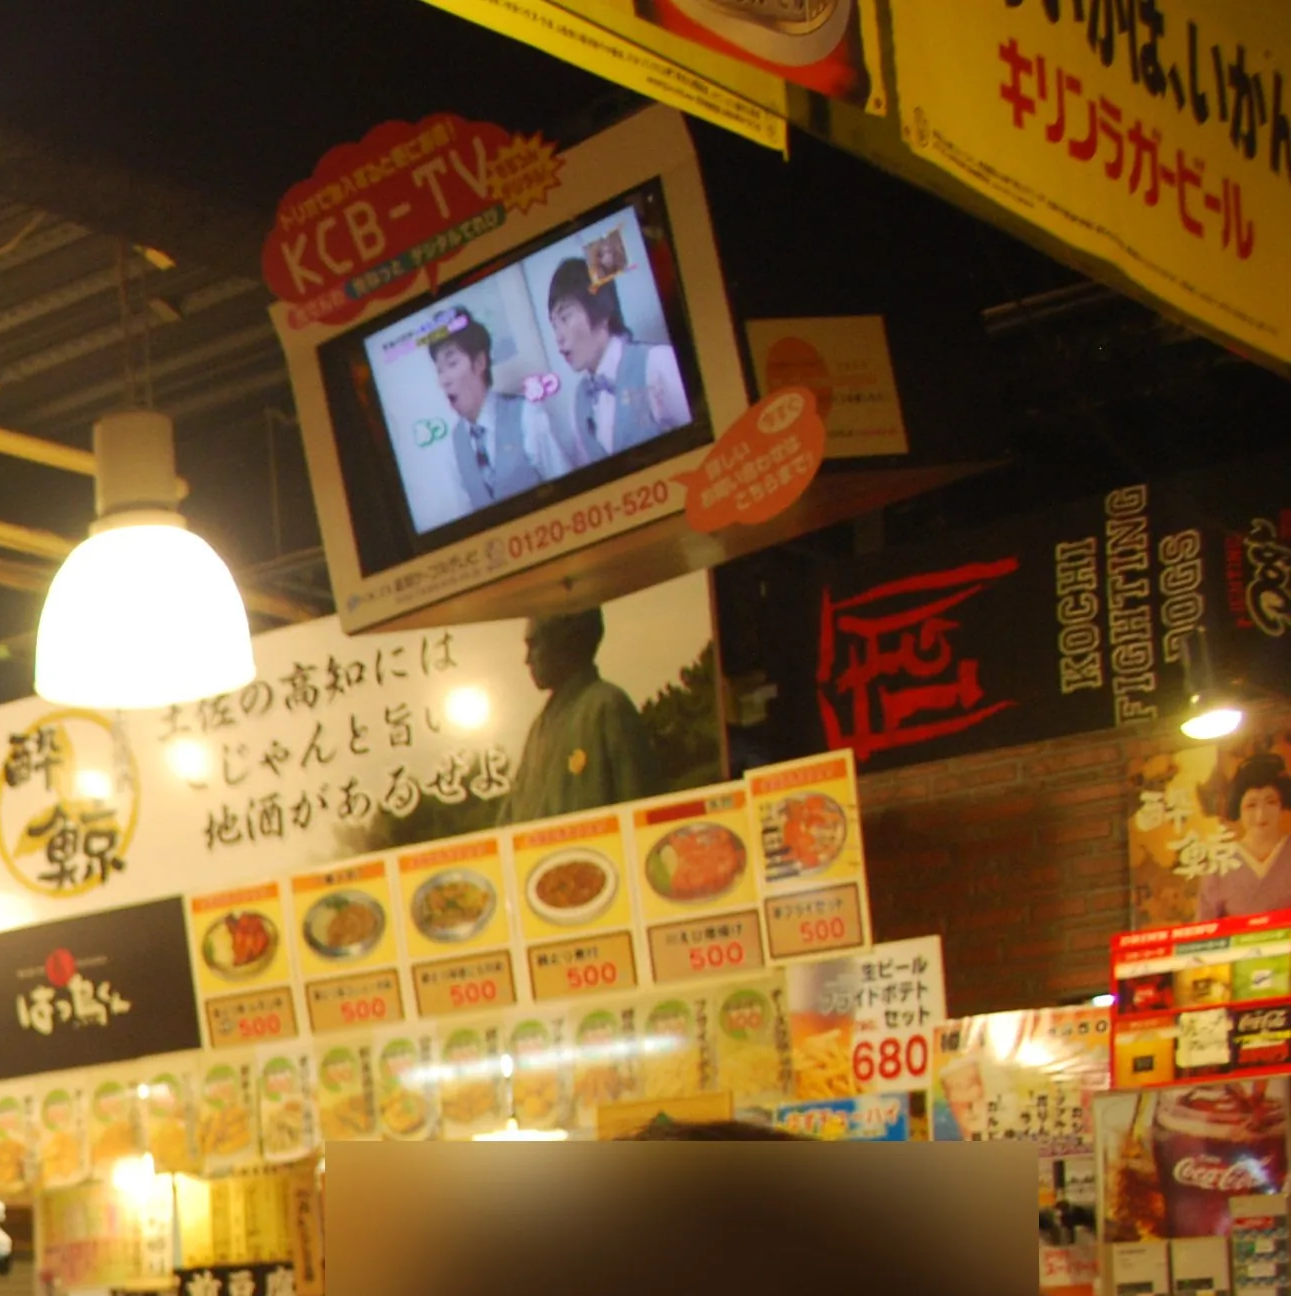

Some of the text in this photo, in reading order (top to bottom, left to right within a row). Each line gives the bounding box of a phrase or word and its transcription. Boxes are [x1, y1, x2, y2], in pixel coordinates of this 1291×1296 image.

[998, 37, 1256, 261] キリンラガービール
[280, 135, 490, 296] KCB-TV
[507, 478, 670, 561] 0120-801-520
[1055, 536, 1104, 695] KOCHI
[1106, 483, 1158, 728] FIGHTING
[204, 744, 512, 849] 地酒があるぜよ
[689, 940, 745, 970] 500
[799, 916, 845, 943] 500
[450, 979, 498, 1008] 500
[566, 961, 617, 989] 500
[884, 1005, 931, 1030] セット
[852, 1034, 929, 1083] 680
